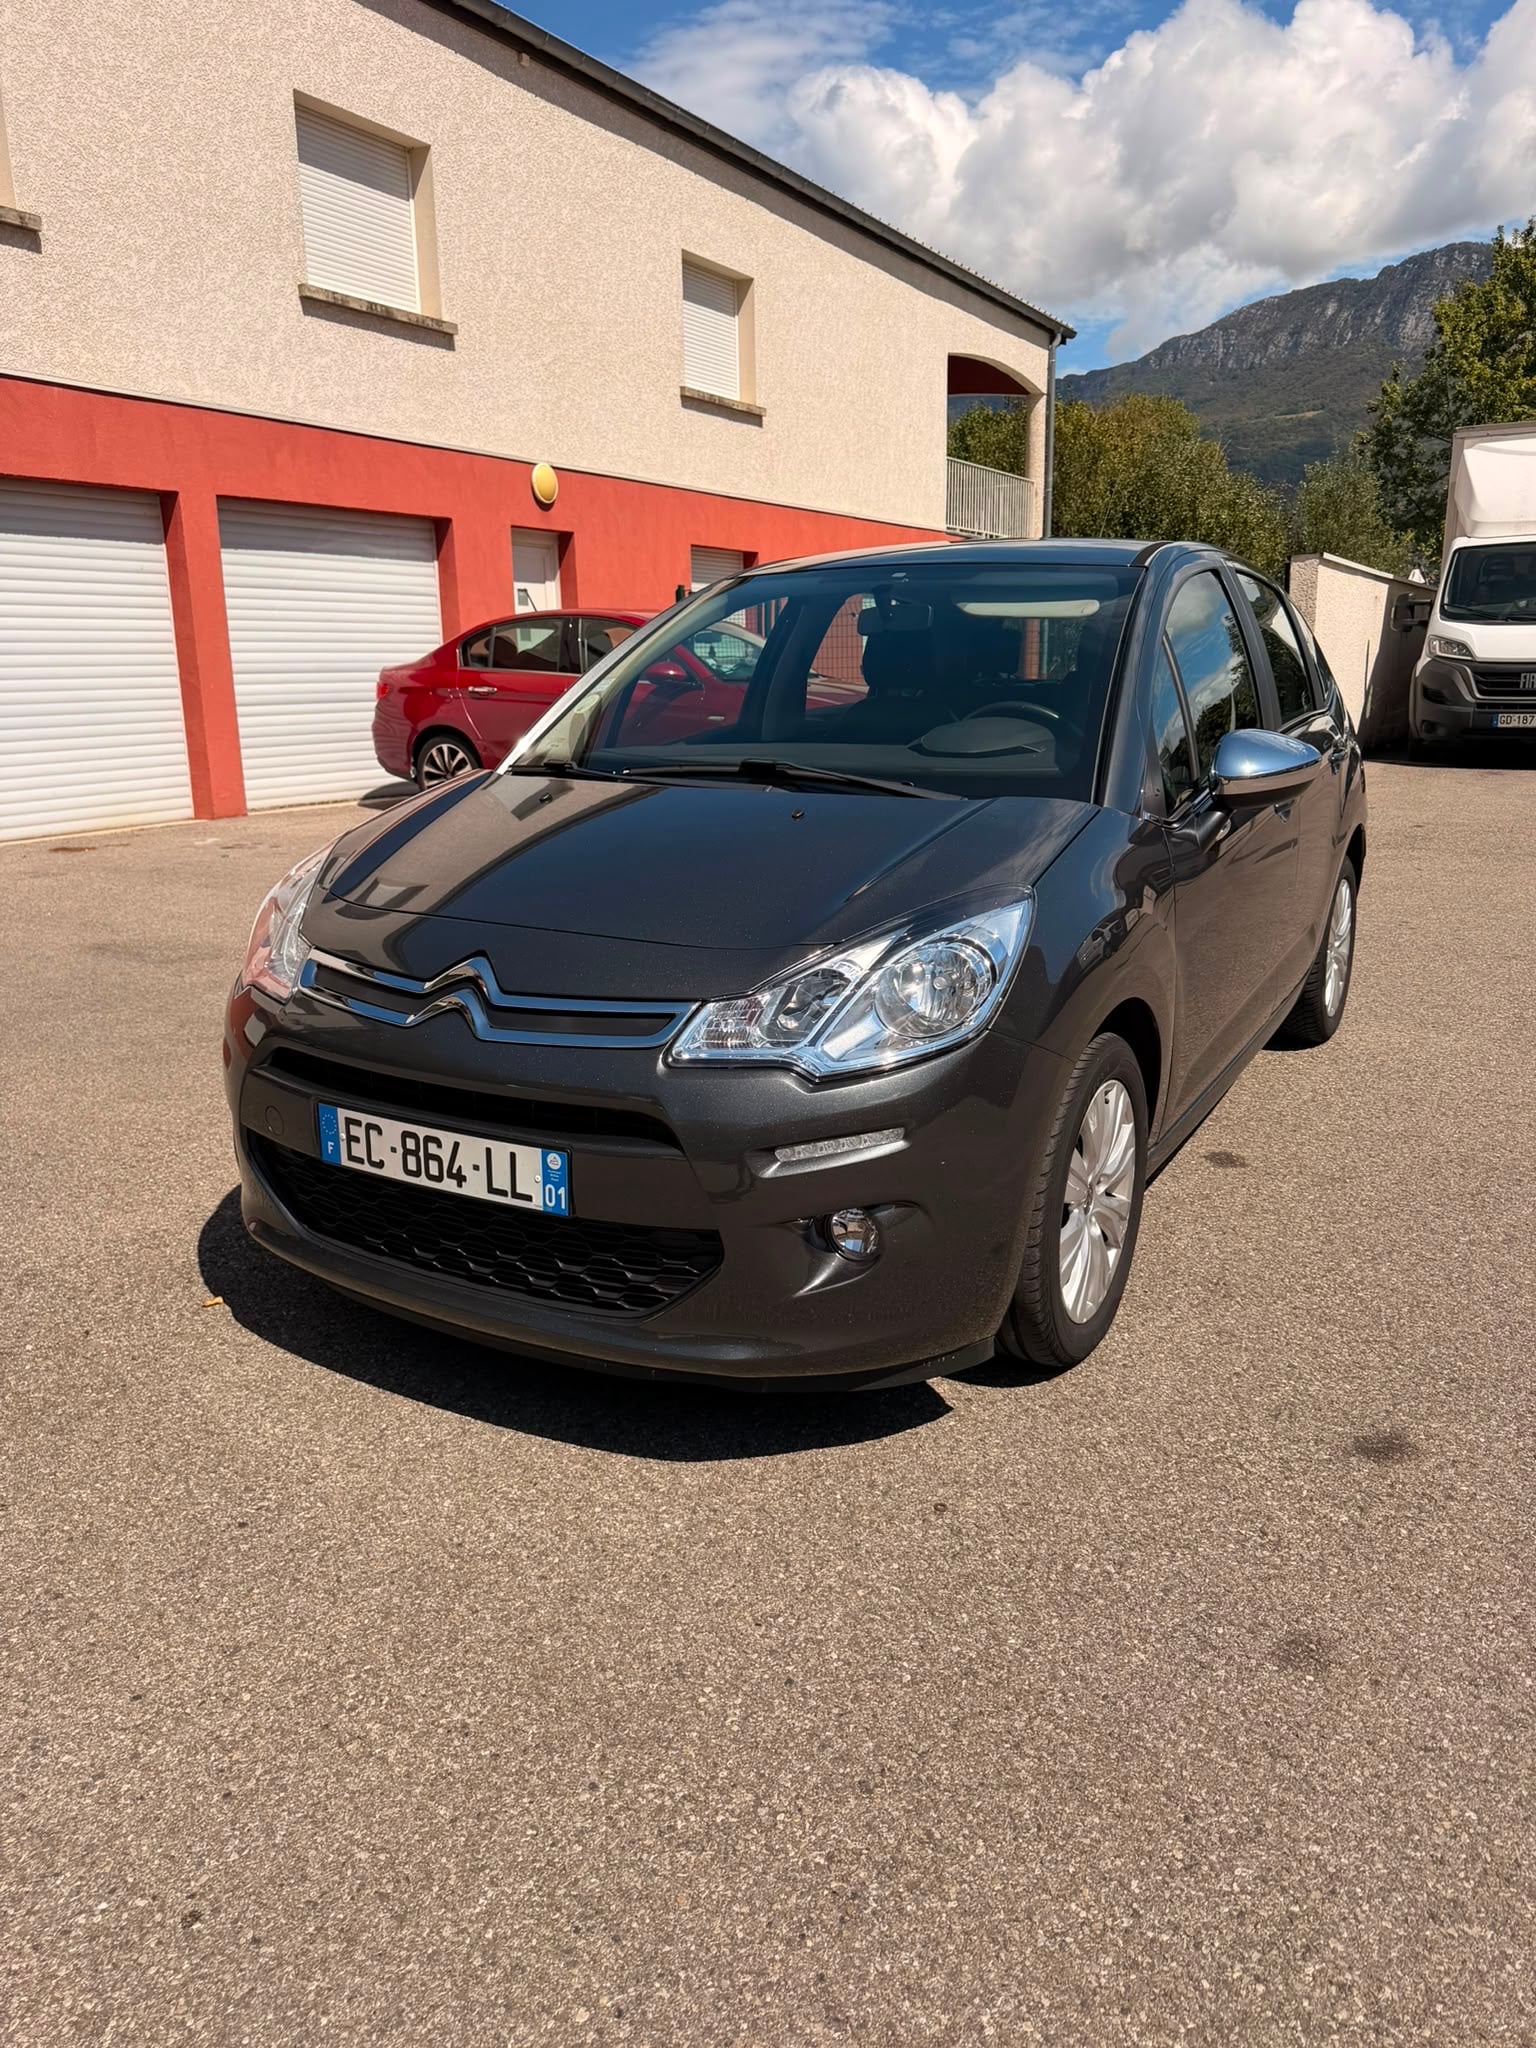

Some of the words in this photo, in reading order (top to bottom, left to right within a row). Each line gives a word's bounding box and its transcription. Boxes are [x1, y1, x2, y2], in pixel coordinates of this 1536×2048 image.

[327, 1141, 335, 1154] F
[344, 1116, 533, 1202] EC-864-LL
[545, 1184, 566, 1209] 01
